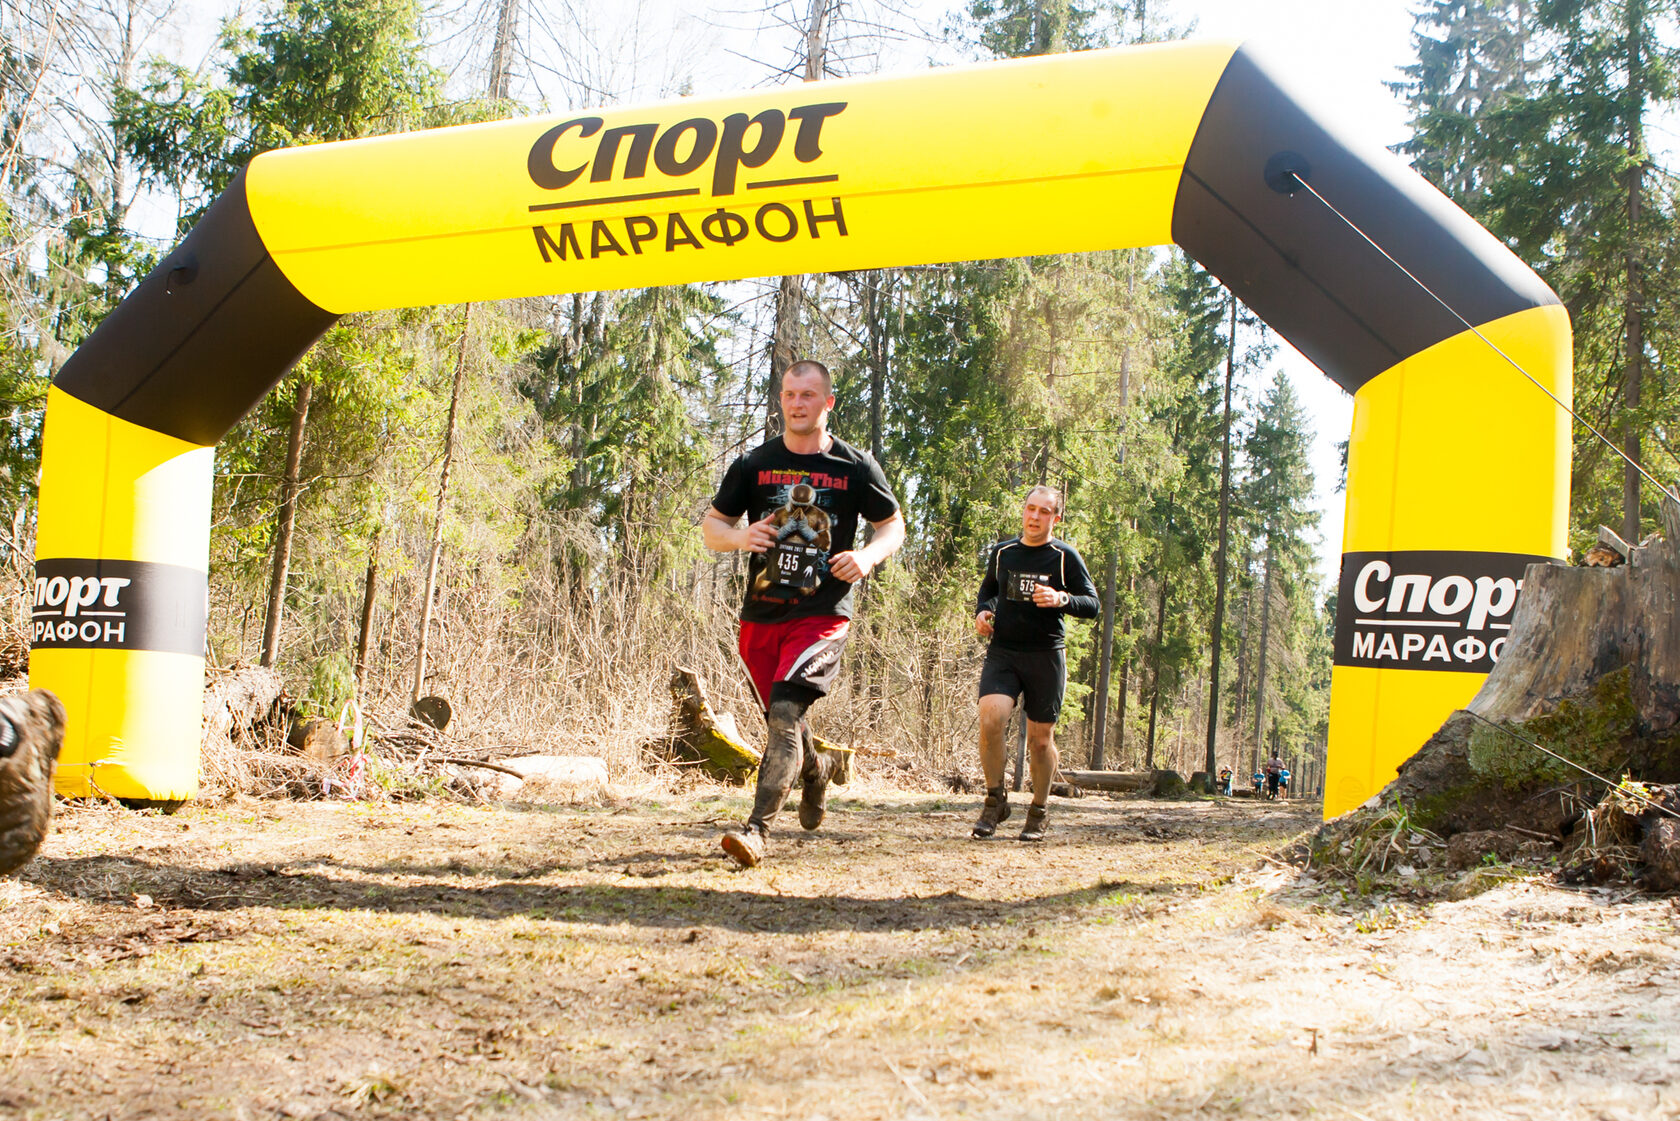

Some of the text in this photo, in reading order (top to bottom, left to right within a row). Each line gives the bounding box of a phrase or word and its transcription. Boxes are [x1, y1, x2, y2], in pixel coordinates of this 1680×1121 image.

[527, 102, 848, 197] Спорт
[532, 197, 849, 263] МАРАФОН
[758, 470, 803, 485] Muay
[809, 472, 849, 490] Thai
[777, 552, 799, 571] 435
[1019, 579, 1035, 592] 575
[1354, 560, 1524, 630] Спор
[32, 621, 125, 643] РАФОН
